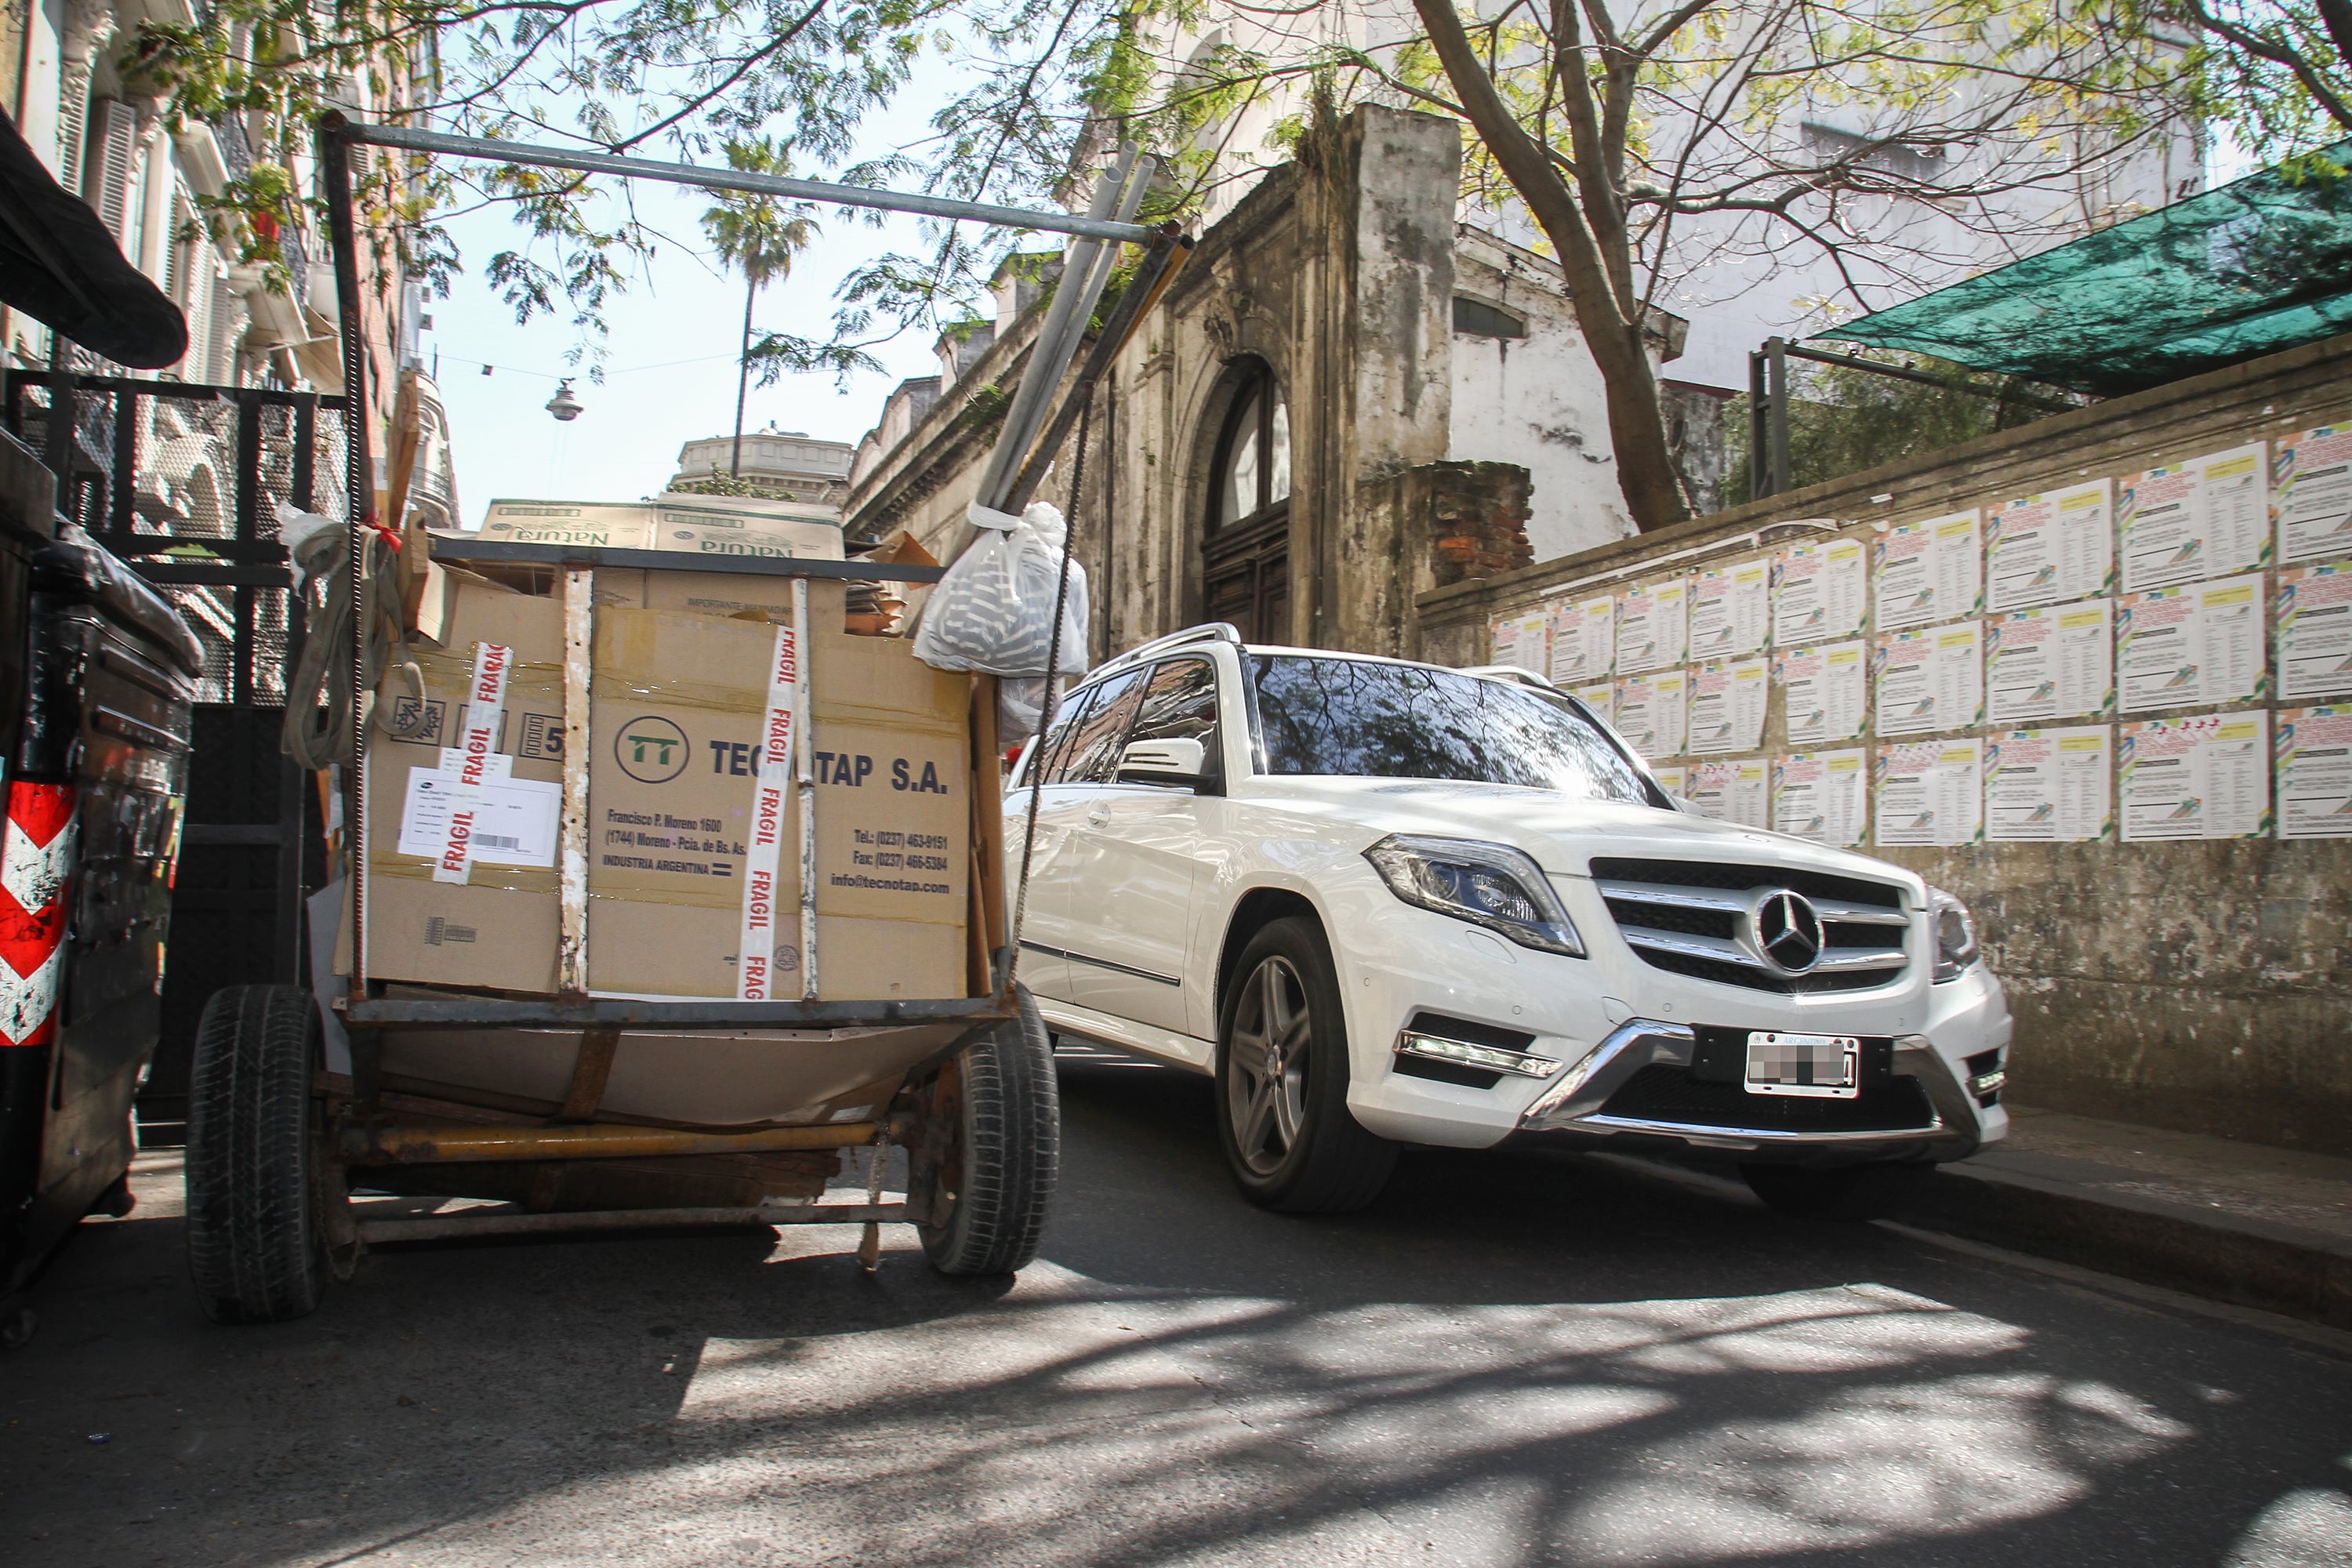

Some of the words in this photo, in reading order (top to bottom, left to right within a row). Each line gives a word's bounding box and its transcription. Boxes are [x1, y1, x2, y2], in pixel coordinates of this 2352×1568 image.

[766, 708, 791, 764] FRAGIL
[462, 728, 492, 786] FRAGIL
[710, 740, 873, 787] TECTAP
[891, 757, 948, 795] S.A.
[608, 808, 653, 826] Francisco
[654, 813, 662, 827] P.
[664, 814, 698, 831] Moreno
[699, 818, 722, 833] 1600
[757, 787, 781, 846] FRAGIL
[442, 811, 474, 872] FRAGIL
[606, 829, 635, 848] (1744)
[637, 833, 671, 848] Moreno
[677, 836, 701, 852] Pcia.
[702, 840, 714, 853] de
[715, 840, 731, 854] Bs.
[732, 842, 746, 856] As.
[854, 829, 874, 844] Tel.:
[877, 830, 905, 850] (0237)
[907, 833, 948, 850] 463-9151
[603, 854, 653, 870] INDUSTRIA
[655, 859, 710, 876] ARGENTINA
[853, 850, 873, 866] Fax:
[876, 851, 904, 871] (0237)
[749, 870, 771, 931] FRAGIL
[831, 873, 949, 895] info@tecnotap.com
